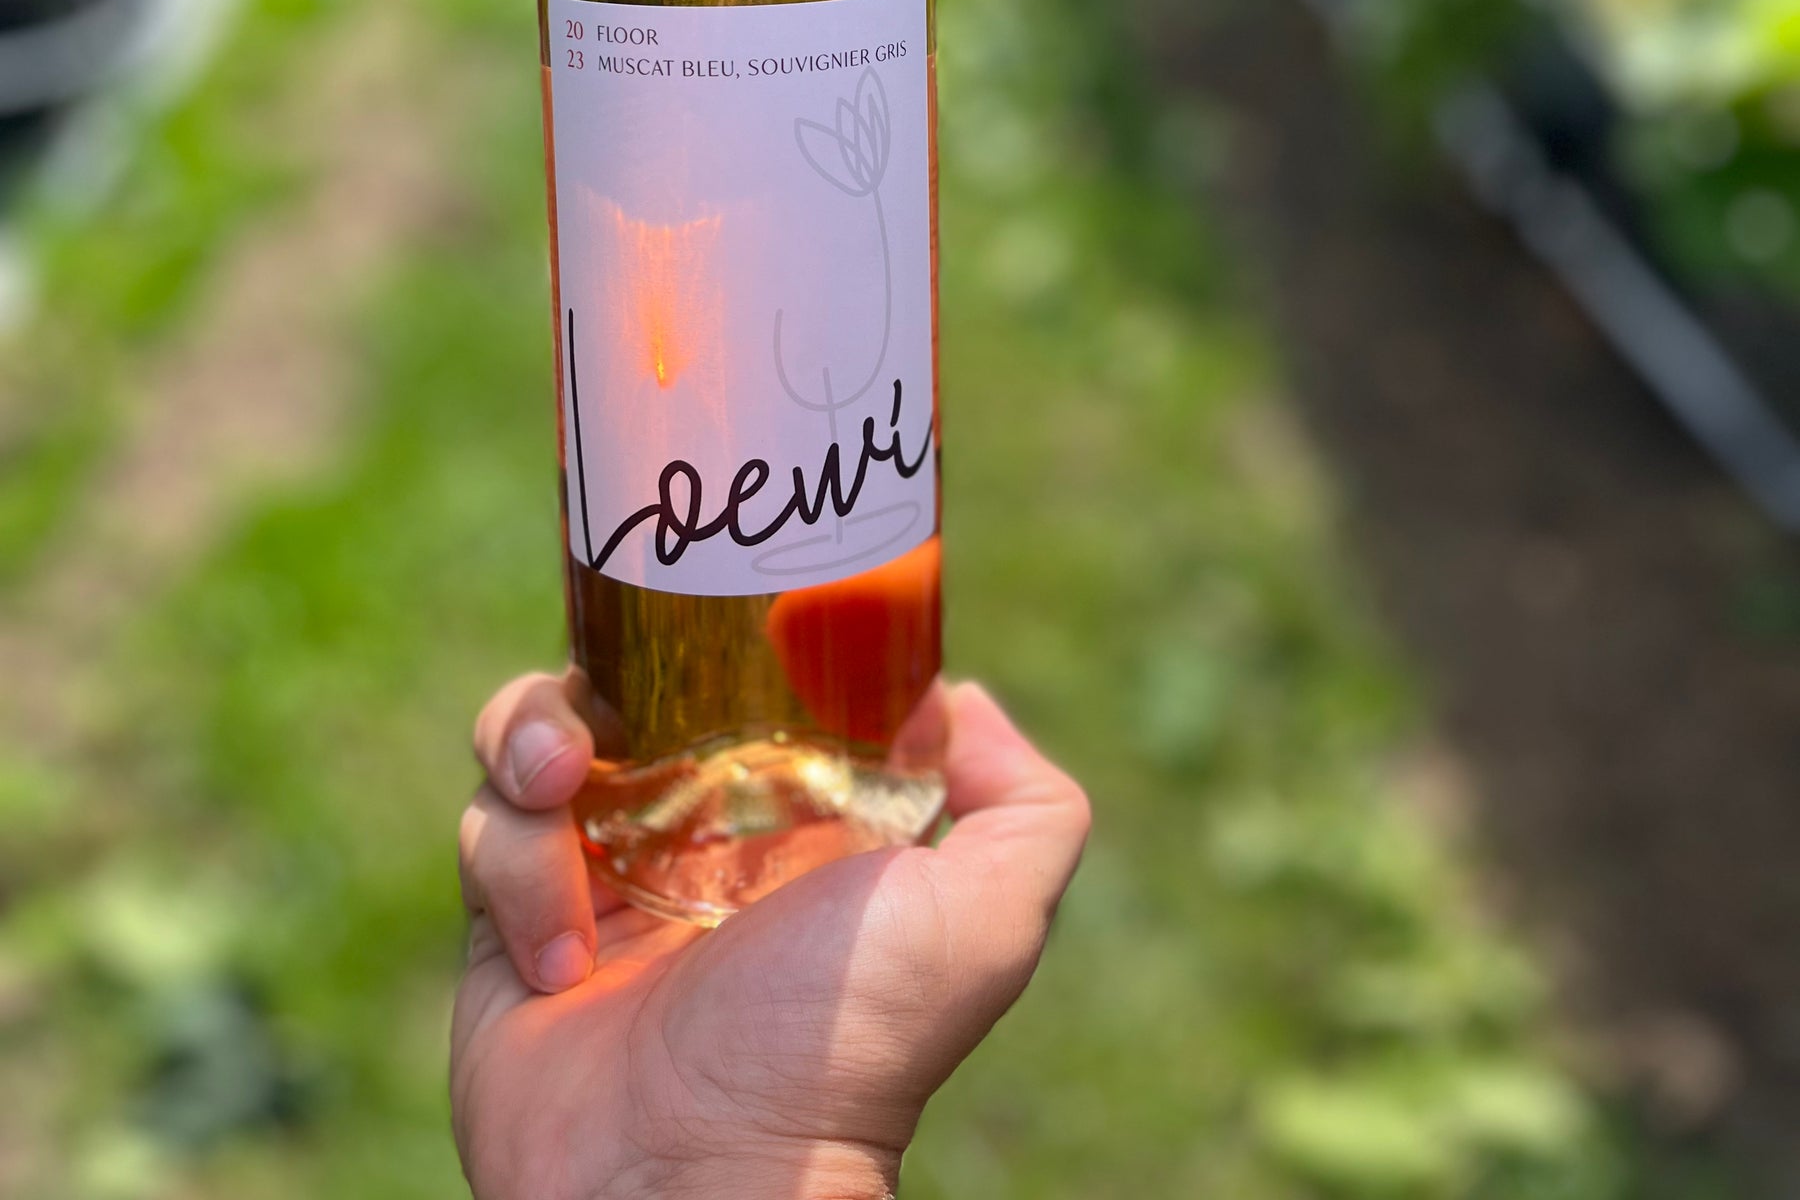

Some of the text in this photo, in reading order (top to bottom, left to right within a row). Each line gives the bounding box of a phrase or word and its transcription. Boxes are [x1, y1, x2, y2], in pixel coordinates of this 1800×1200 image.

[565, 19, 659, 46] 20 FLOOR
[567, 40, 907, 80] 23 MUSCAT BLEU, SOUVIGNIER GRIS
